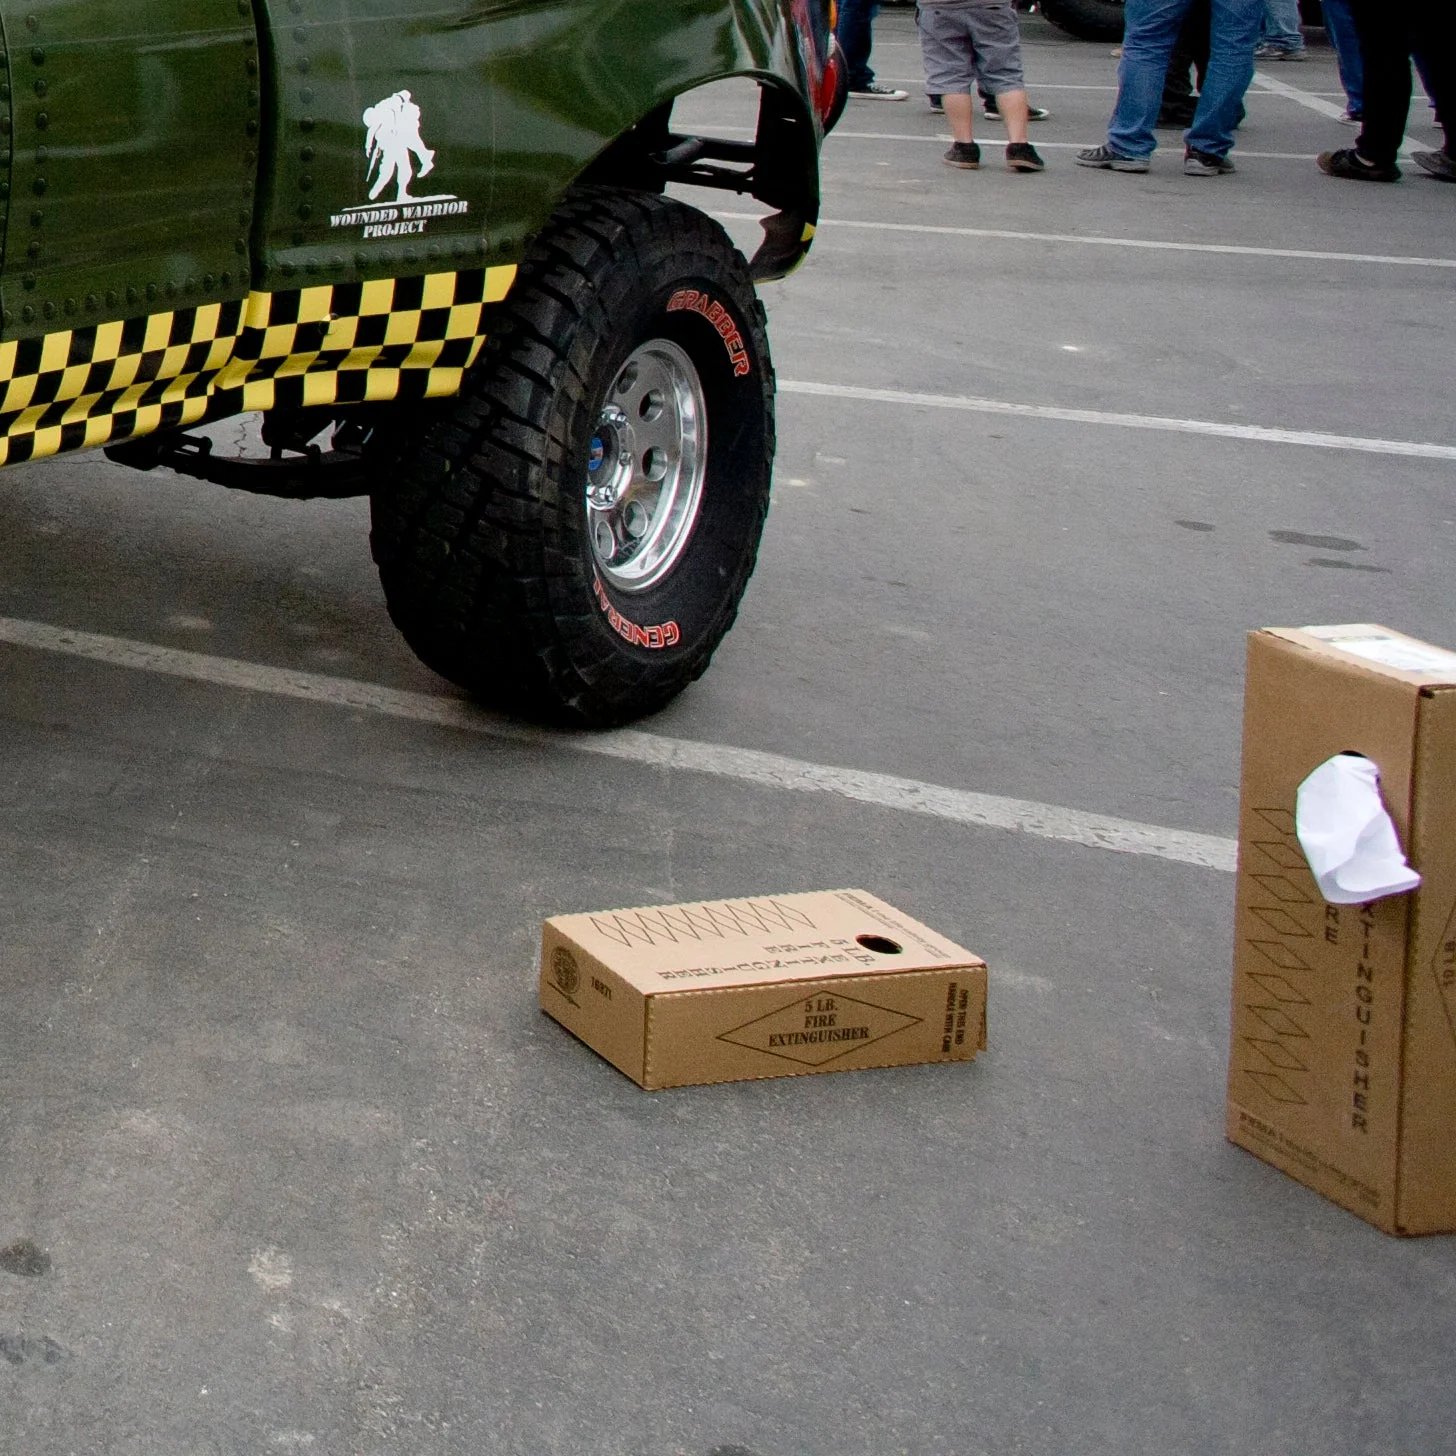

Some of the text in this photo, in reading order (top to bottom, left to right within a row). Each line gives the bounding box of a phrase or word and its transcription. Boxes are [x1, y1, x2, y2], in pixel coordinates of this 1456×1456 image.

[330, 200, 469, 228] WOUNDED WARRIOR
[363, 219, 428, 239] PROJECT
[666, 288, 750, 377] GRABBER
[1324, 905, 1339, 945] RE
[804, 998, 839, 1013] 5 LB.
[804, 1013, 837, 1029] FIRE
[1351, 903, 1374, 1134] XTINGUISHER
[767, 1026, 870, 1048] EXTINGUISHER
